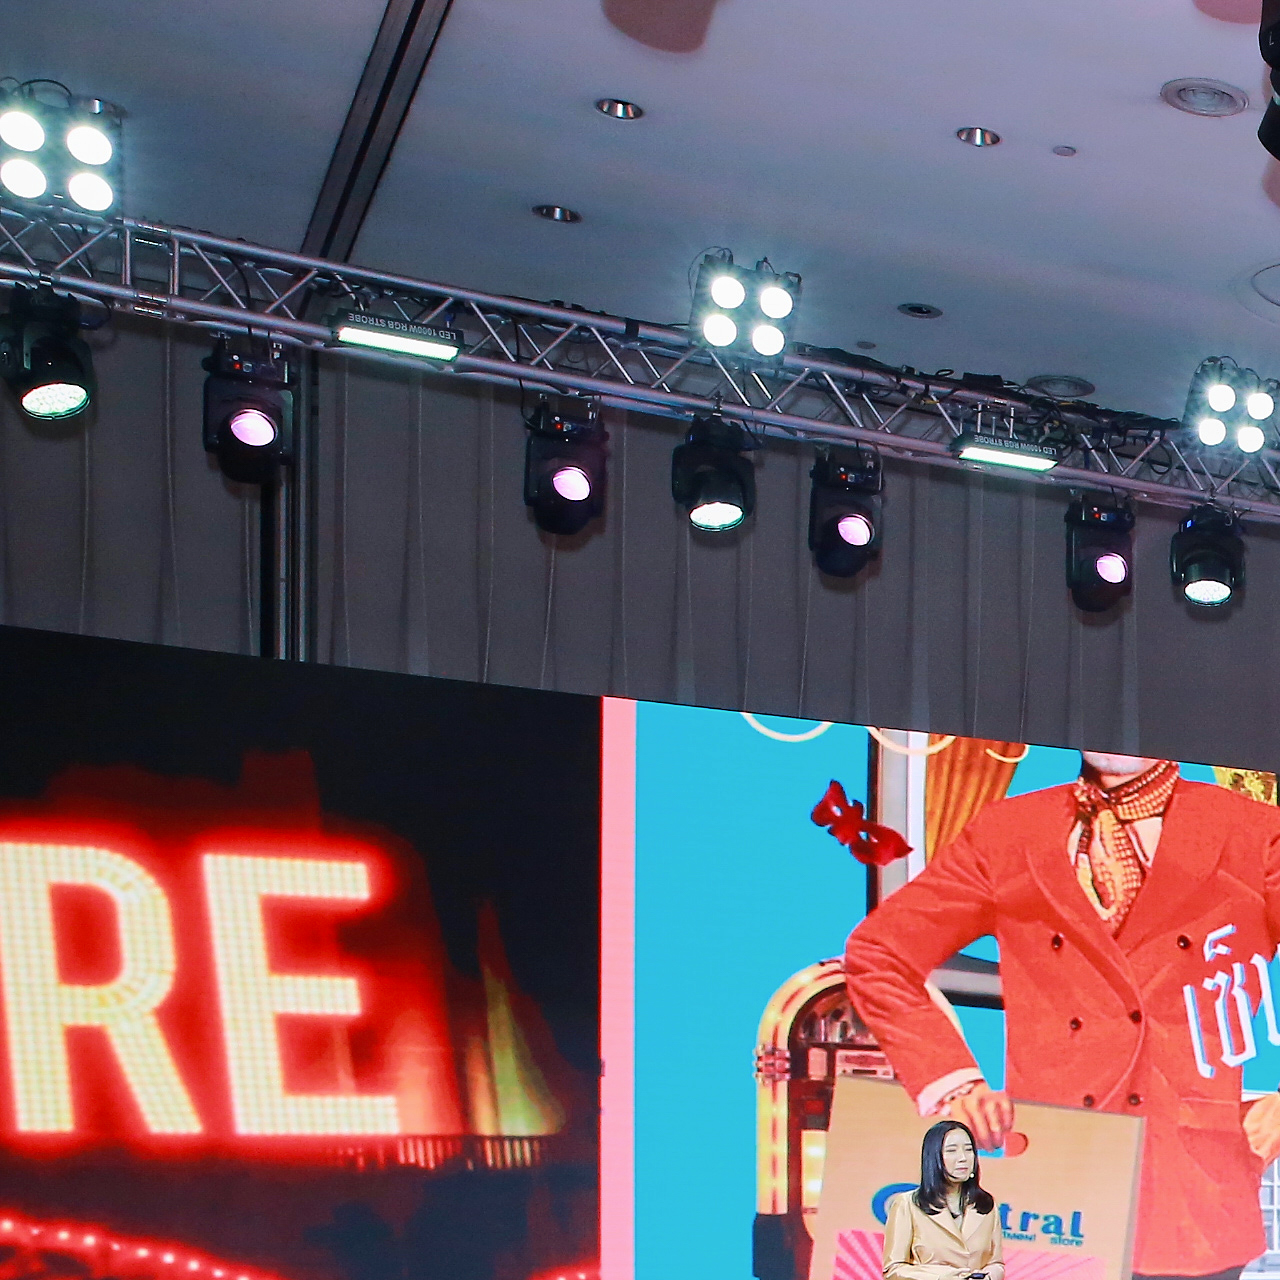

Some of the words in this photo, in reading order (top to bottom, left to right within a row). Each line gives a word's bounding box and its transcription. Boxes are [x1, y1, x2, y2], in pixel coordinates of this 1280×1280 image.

[348, 312, 386, 328] STROBE
[387, 318, 408, 332] RGB
[408, 323, 437, 337] 1000W
[438, 329, 457, 341] LED
[0, 842, 401, 1135] RE
